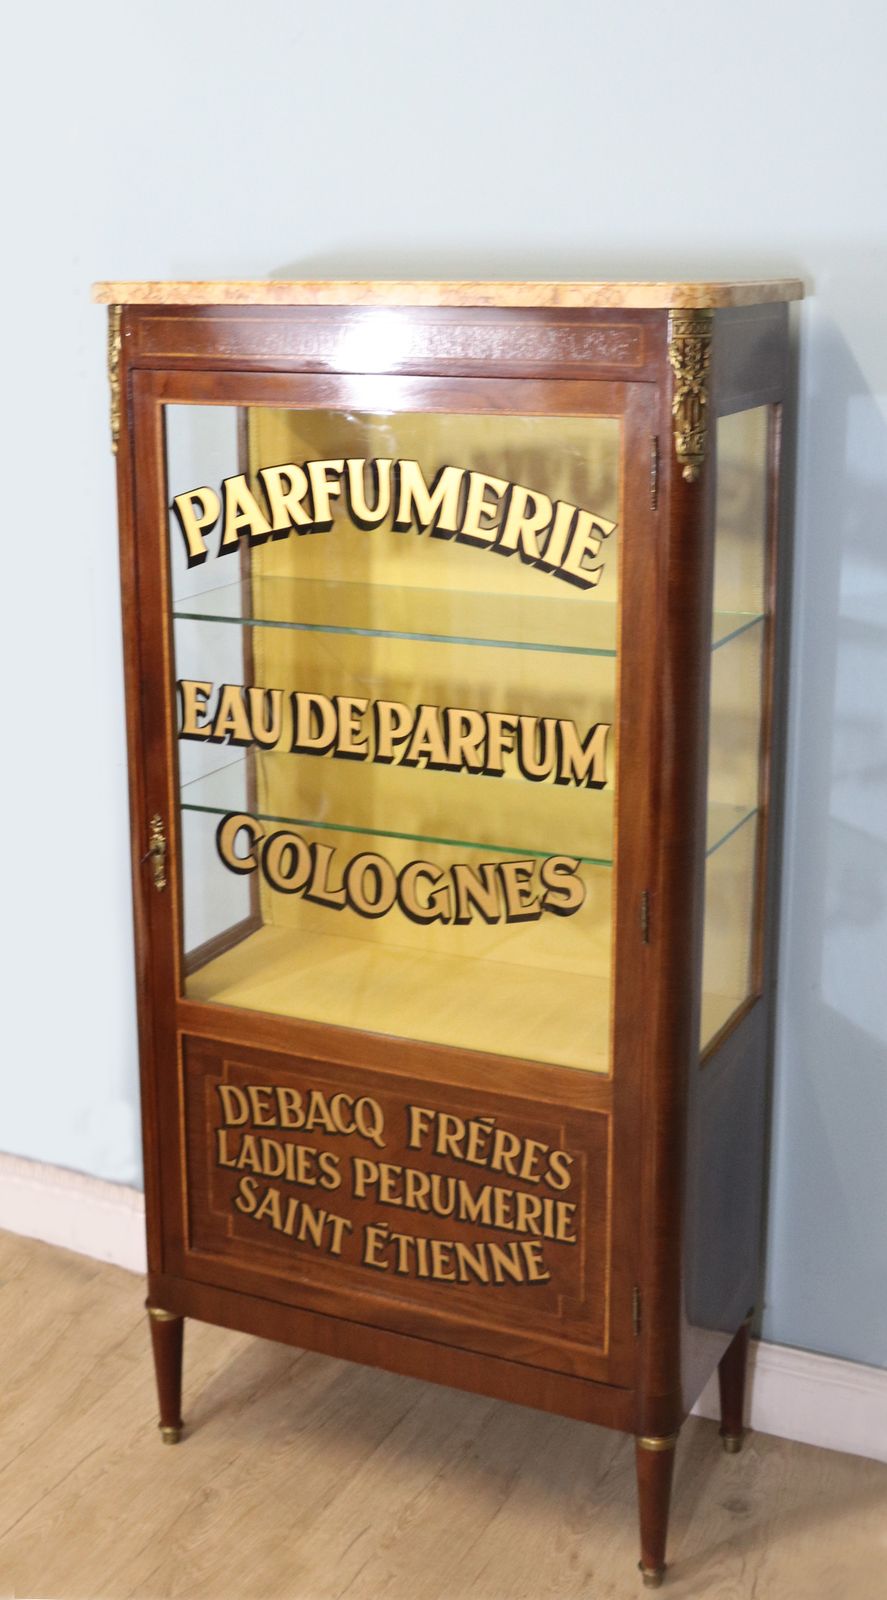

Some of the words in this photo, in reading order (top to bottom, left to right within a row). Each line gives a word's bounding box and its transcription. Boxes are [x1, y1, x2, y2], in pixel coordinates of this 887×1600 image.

[170, 458, 618, 590] PARFUMERIE
[177, 679, 285, 750] EAU
[290, 691, 371, 762] DE
[374, 700, 611, 790] PARFUM
[215, 811, 587, 926] COLOGNES
[217, 1084, 386, 1148] DEBACQ
[216, 1128, 343, 1190] LADIES
[352, 1157, 578, 1244] PERUMERIE
[234, 1175, 352, 1256] SAINT
[361, 1220, 552, 1286] ÉTIENNE
